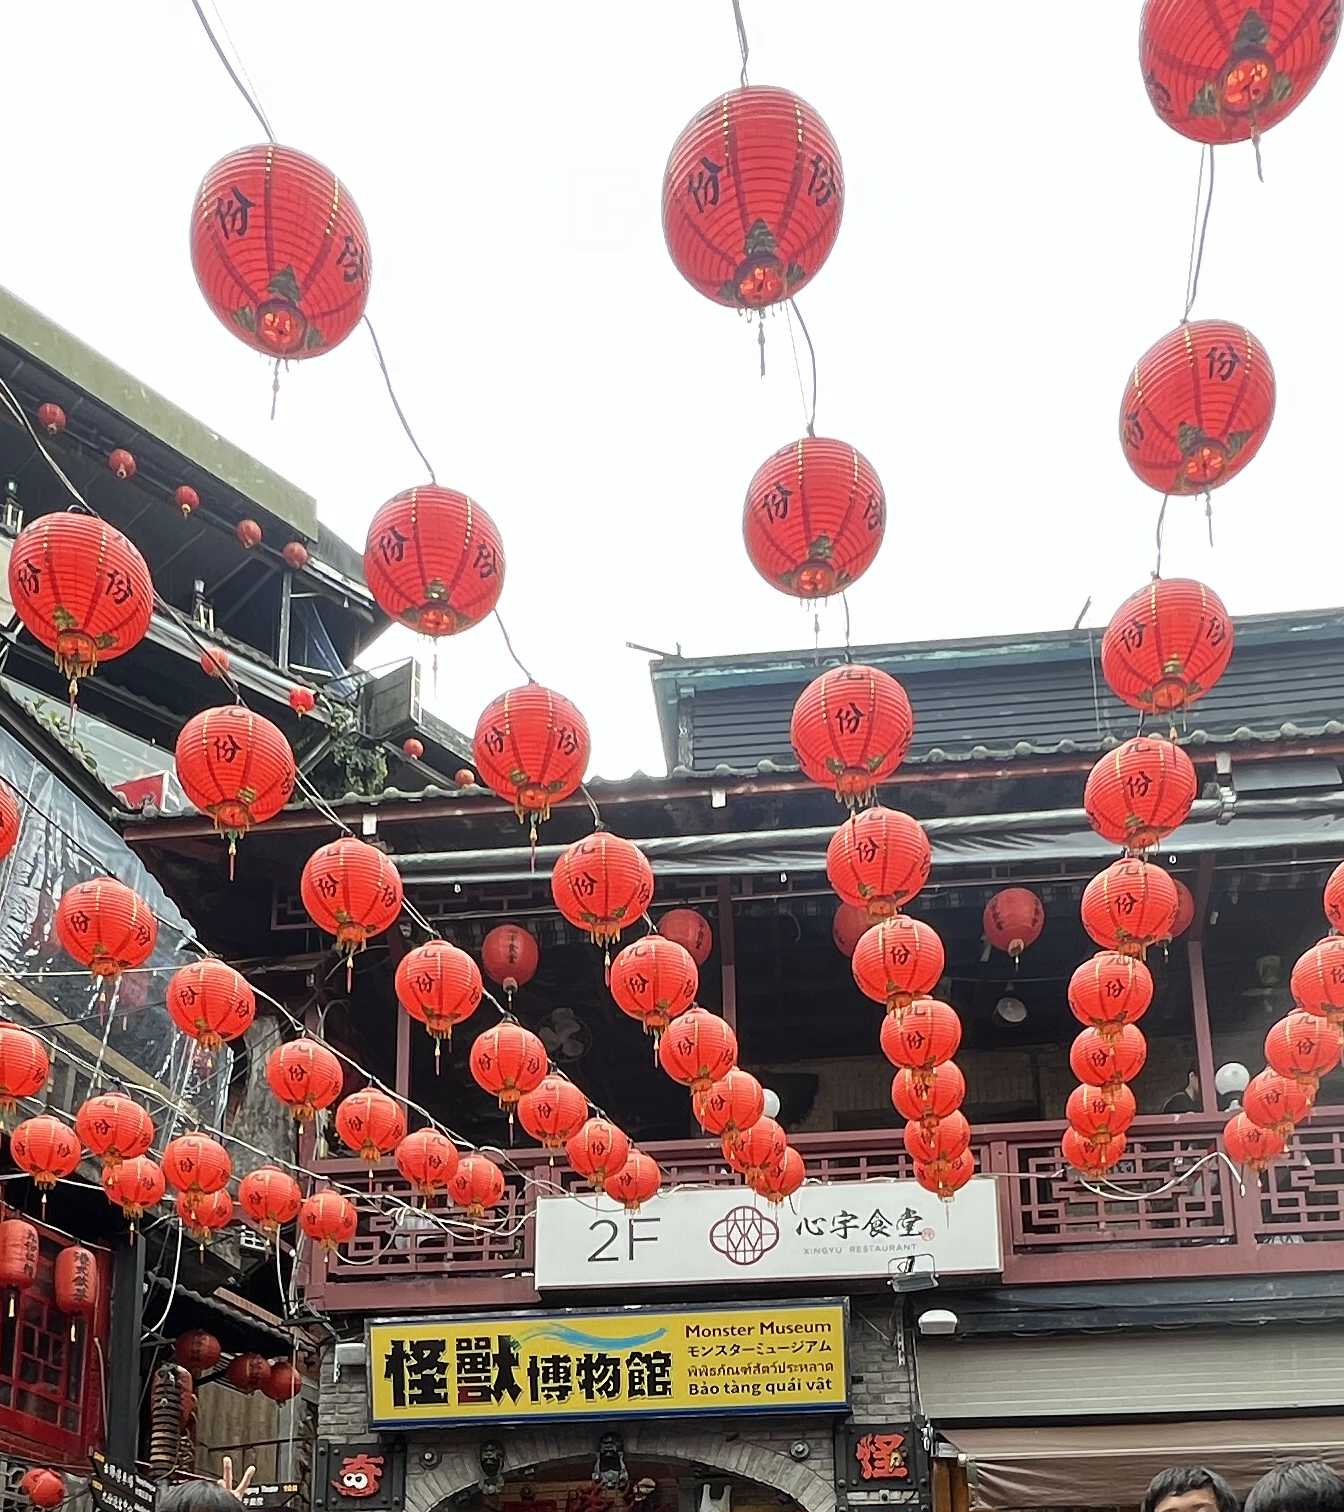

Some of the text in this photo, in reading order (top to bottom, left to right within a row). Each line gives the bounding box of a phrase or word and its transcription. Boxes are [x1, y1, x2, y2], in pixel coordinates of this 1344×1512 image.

[687, 155, 724, 215] 份
[215, 187, 255, 240] 份
[1206, 342, 1242, 382] 份
[762, 480, 793, 524] 份
[378, 525, 410, 566] 份
[17, 560, 42, 595] 份
[1120, 620, 1147, 653] 份
[214, 734, 241, 763] 份
[484, 726, 507, 757] 份
[557, 726, 580, 757] 份
[70, 910, 90, 934] 份
[587, 1216, 661, 1263] 2F
[849, 1242, 918, 1255] RESTAURANT
[685, 1321, 831, 1339] Monster Museum
[687, 1340, 833, 1358] モンスターミュージアム
[688, 1376, 833, 1397] Bảo tàng quái vật
